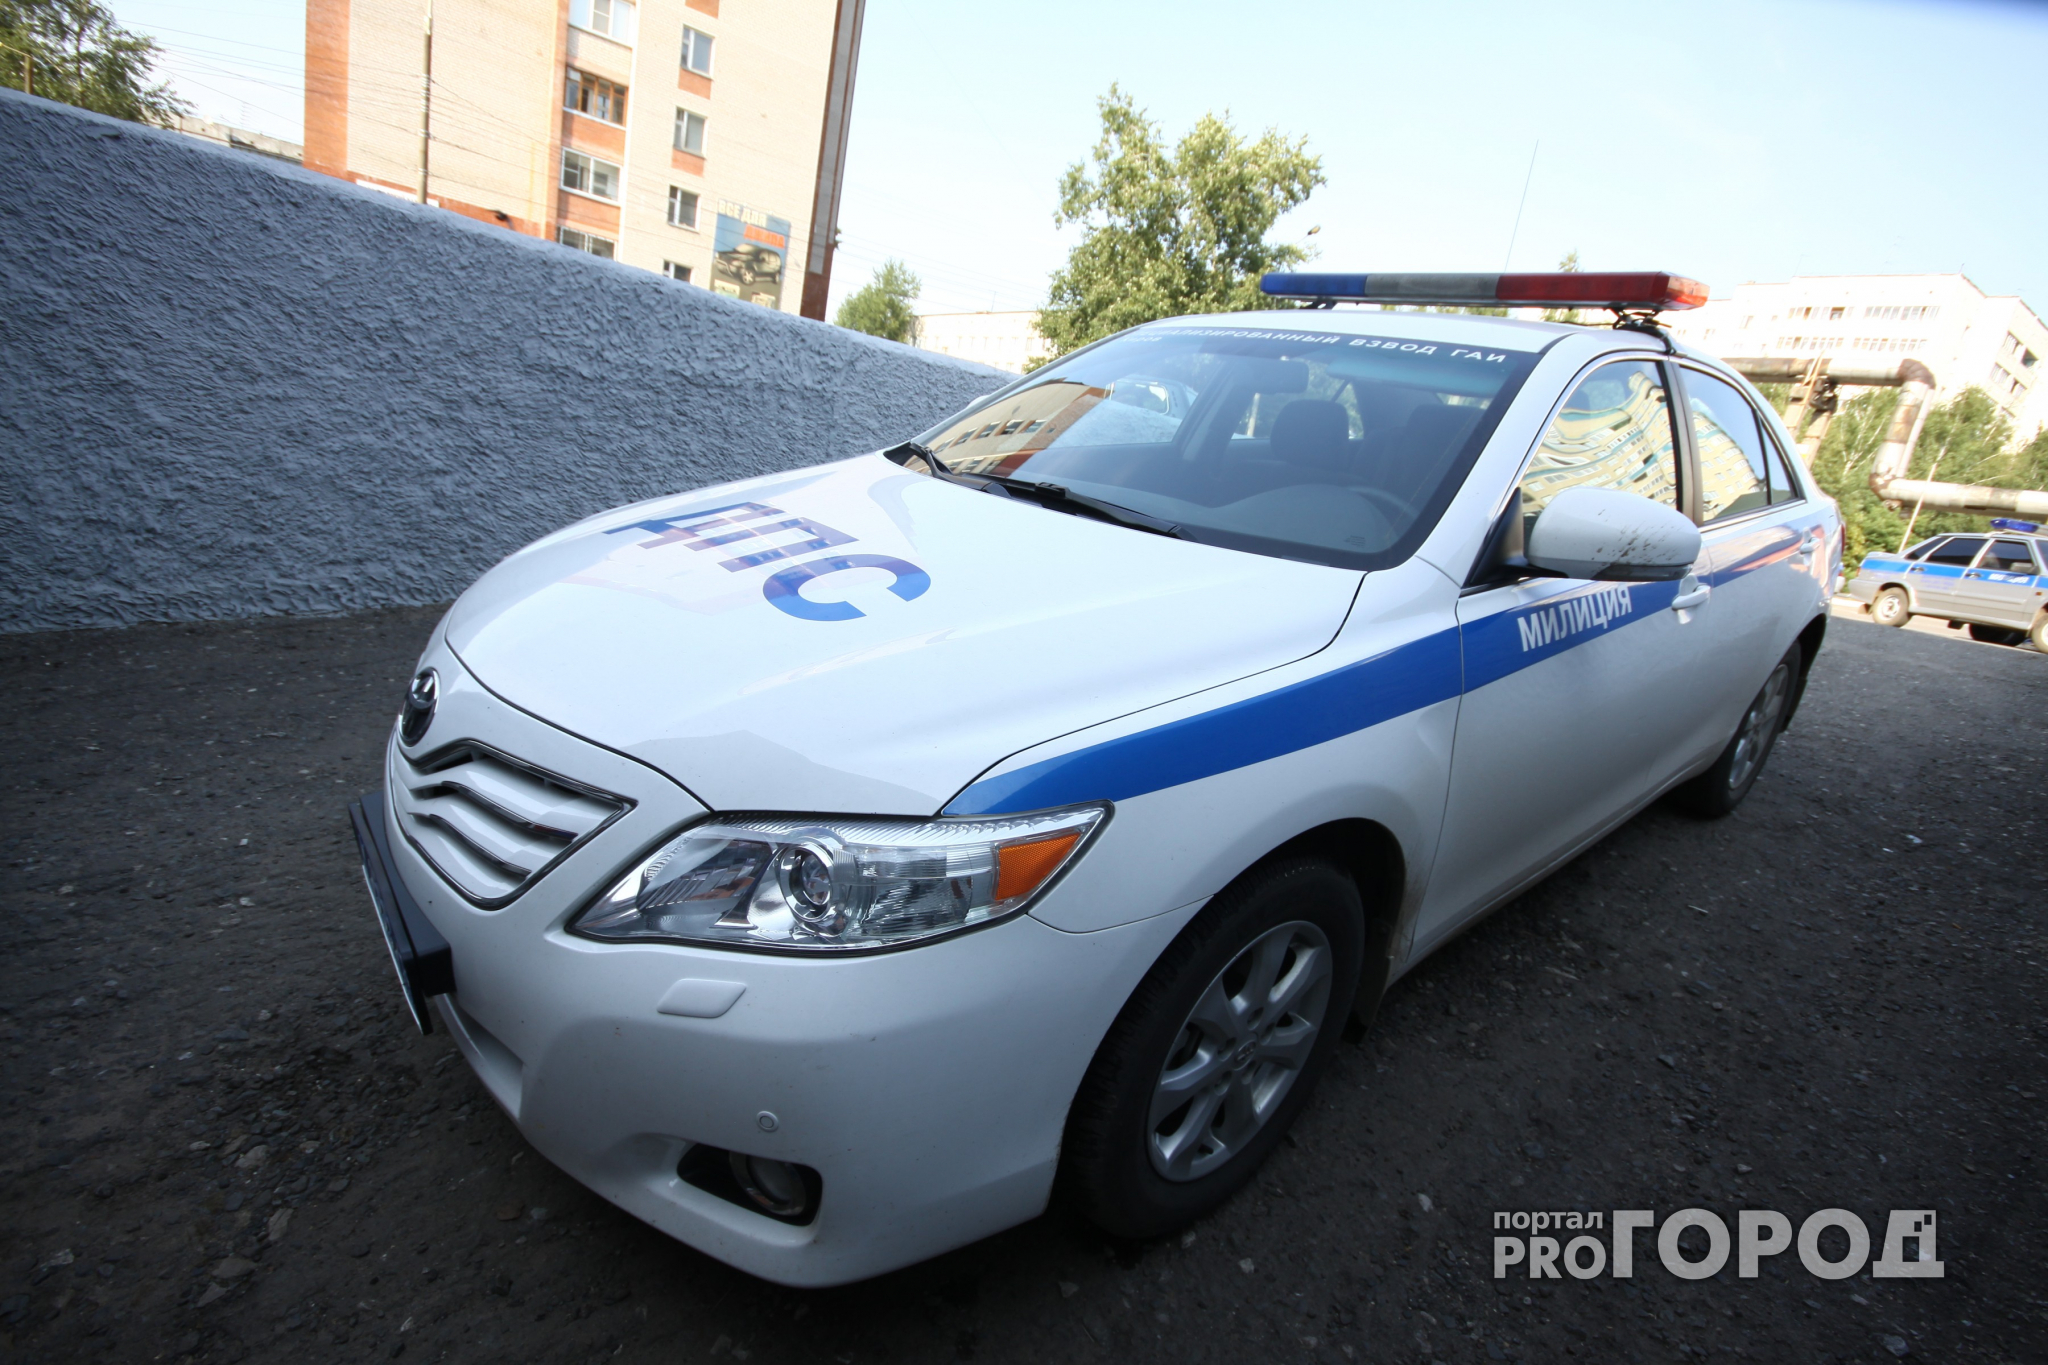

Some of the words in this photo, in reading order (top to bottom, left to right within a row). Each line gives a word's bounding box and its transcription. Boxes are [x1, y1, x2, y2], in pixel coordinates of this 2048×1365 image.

[718, 199, 740, 219] ВСЕ
[741, 207, 767, 228] ДЛЯ
[1137, 329, 1341, 344] ИАЛИЗИРОВАННЫЙ
[1348, 338, 1438, 356] ВЗВОД
[1450, 348, 1507, 363] ГАИ
[602, 501, 932, 622] ДПС
[1516, 585, 1633, 652] МИЛИЦИЯ
